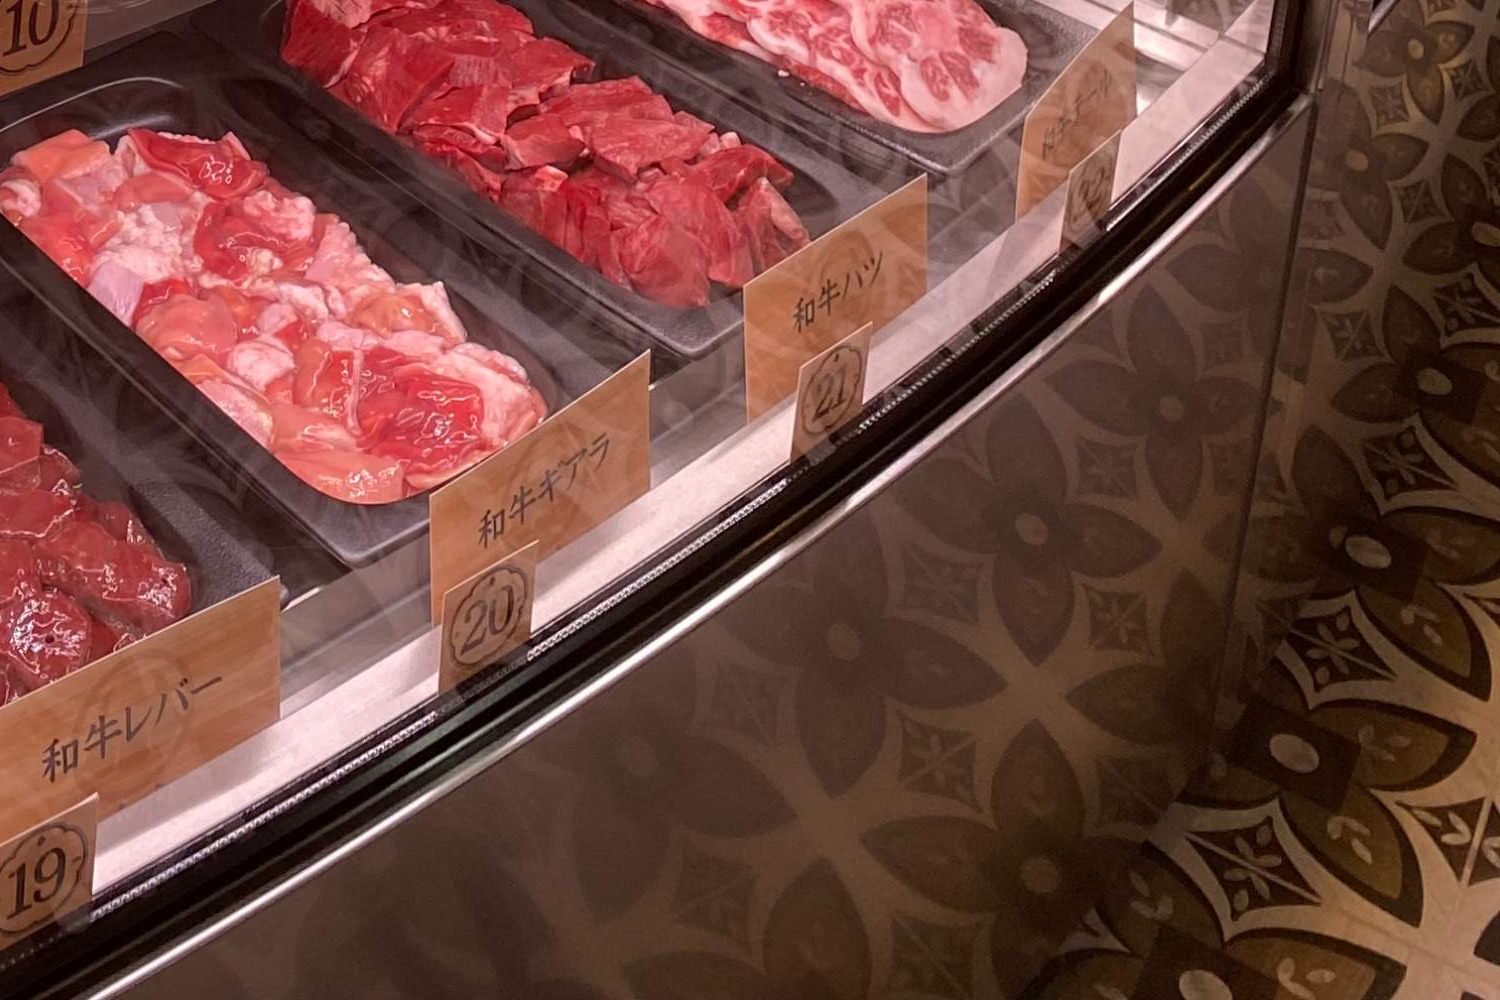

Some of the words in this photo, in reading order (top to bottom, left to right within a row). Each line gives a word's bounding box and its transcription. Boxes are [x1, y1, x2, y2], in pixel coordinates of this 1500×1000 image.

[3, 0, 59, 56] 10
[793, 251, 884, 333] 和牛ハツ
[813, 363, 847, 423] 21
[478, 432, 610, 549] 和牛ギアラ
[460, 585, 516, 656] 20
[41, 675, 223, 783] 和牛レバー
[6, 846, 67, 921] 19
